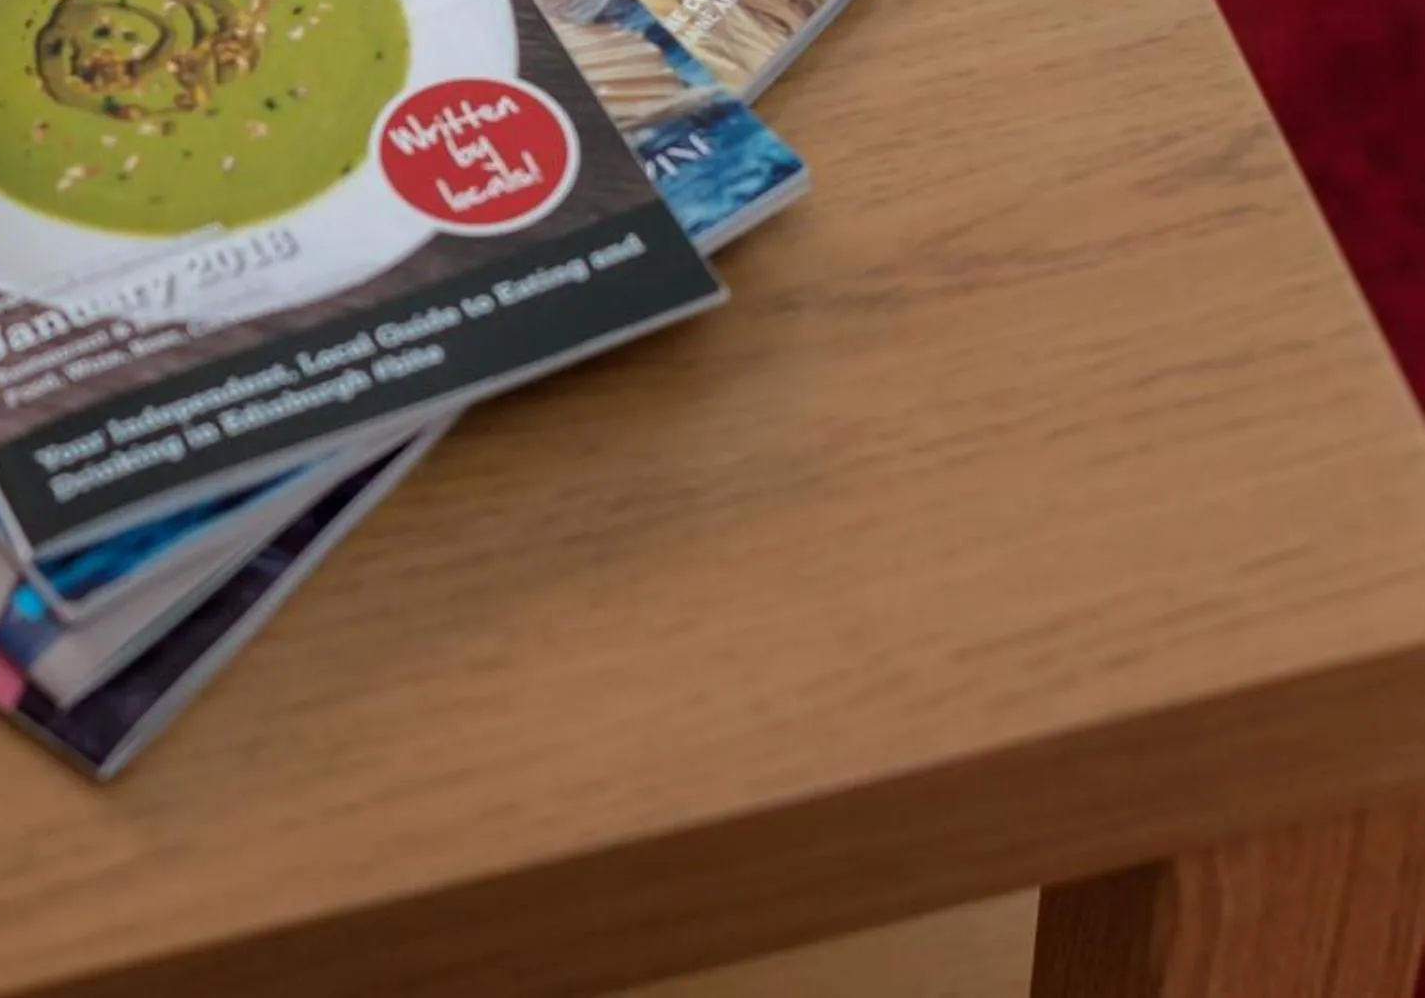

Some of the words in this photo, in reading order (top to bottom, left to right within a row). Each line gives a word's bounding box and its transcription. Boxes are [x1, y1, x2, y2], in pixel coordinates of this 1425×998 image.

[388, 94, 521, 156] Written
[440, 117, 511, 178] by
[185, 228, 303, 287] 2018
[34, 429, 106, 472] Your
[106, 363, 300, 445] Independent,
[296, 331, 377, 377] Local
[373, 306, 463, 349] Guide
[460, 293, 496, 318] to
[492, 258, 590, 306] Eating
[588, 232, 647, 270] and
[48, 434, 186, 502] Drinking
[183, 421, 221, 450] in
[219, 368, 372, 436] Edinburgh
